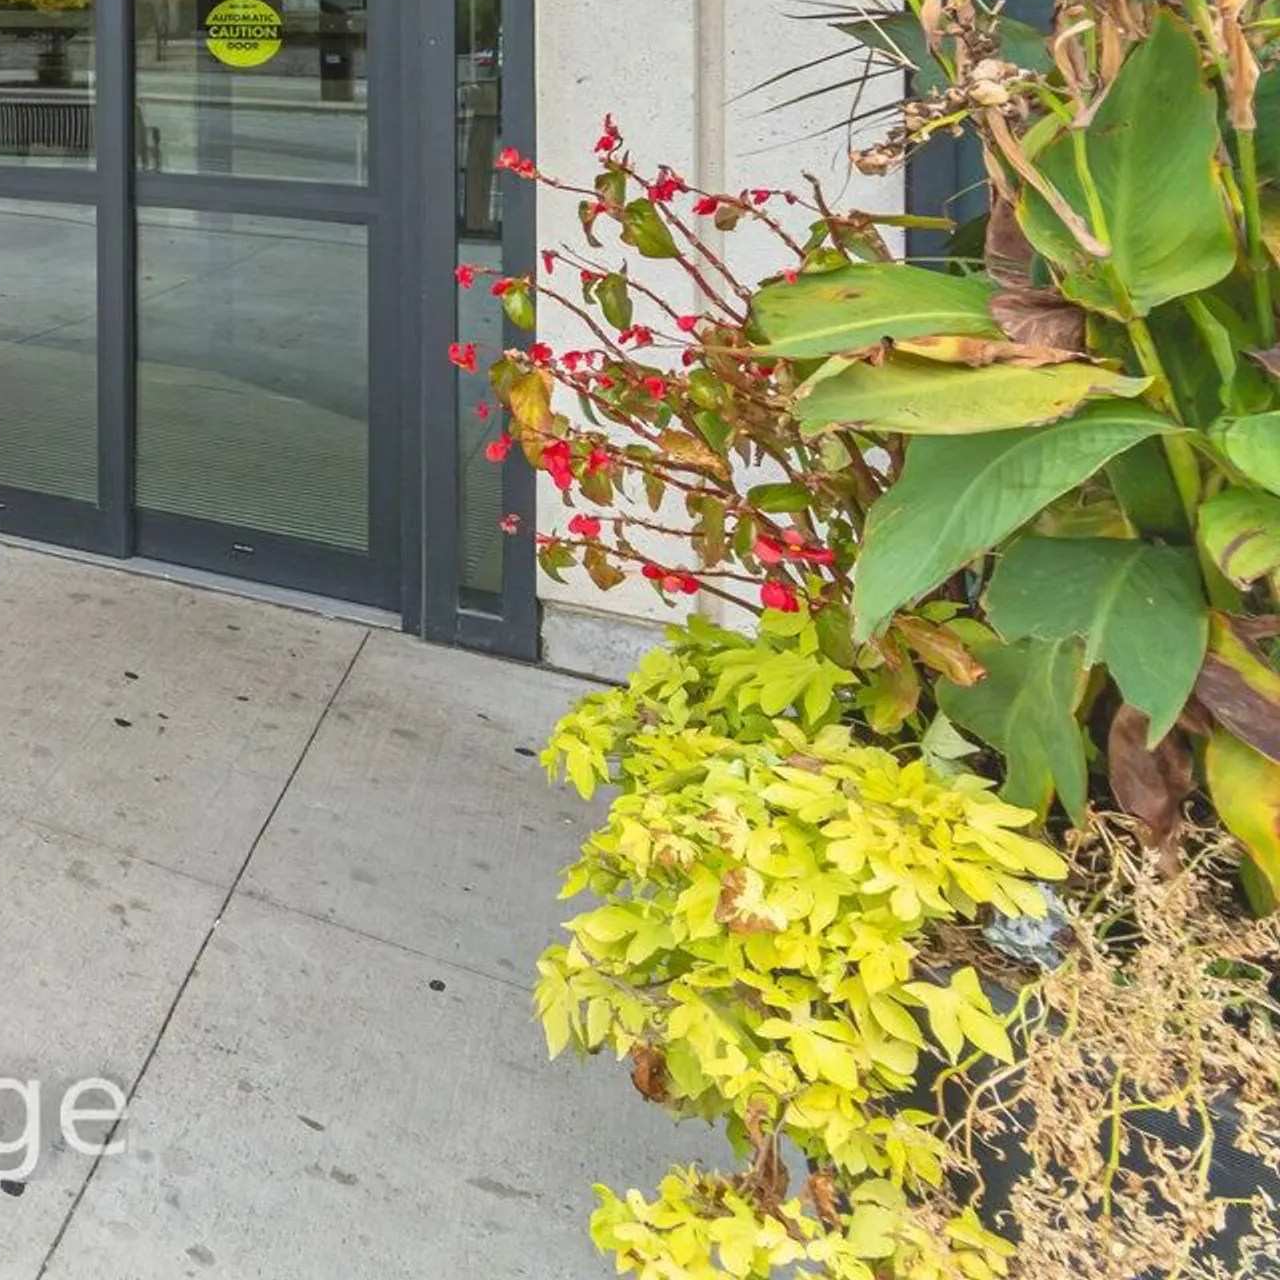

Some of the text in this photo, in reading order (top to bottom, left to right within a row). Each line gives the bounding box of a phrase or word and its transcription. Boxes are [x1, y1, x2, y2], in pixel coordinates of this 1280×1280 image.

[212, 14, 275, 23] AUTOMATIC
[208, 25, 278, 38] CAUTION
[227, 41, 260, 51] DOOR
